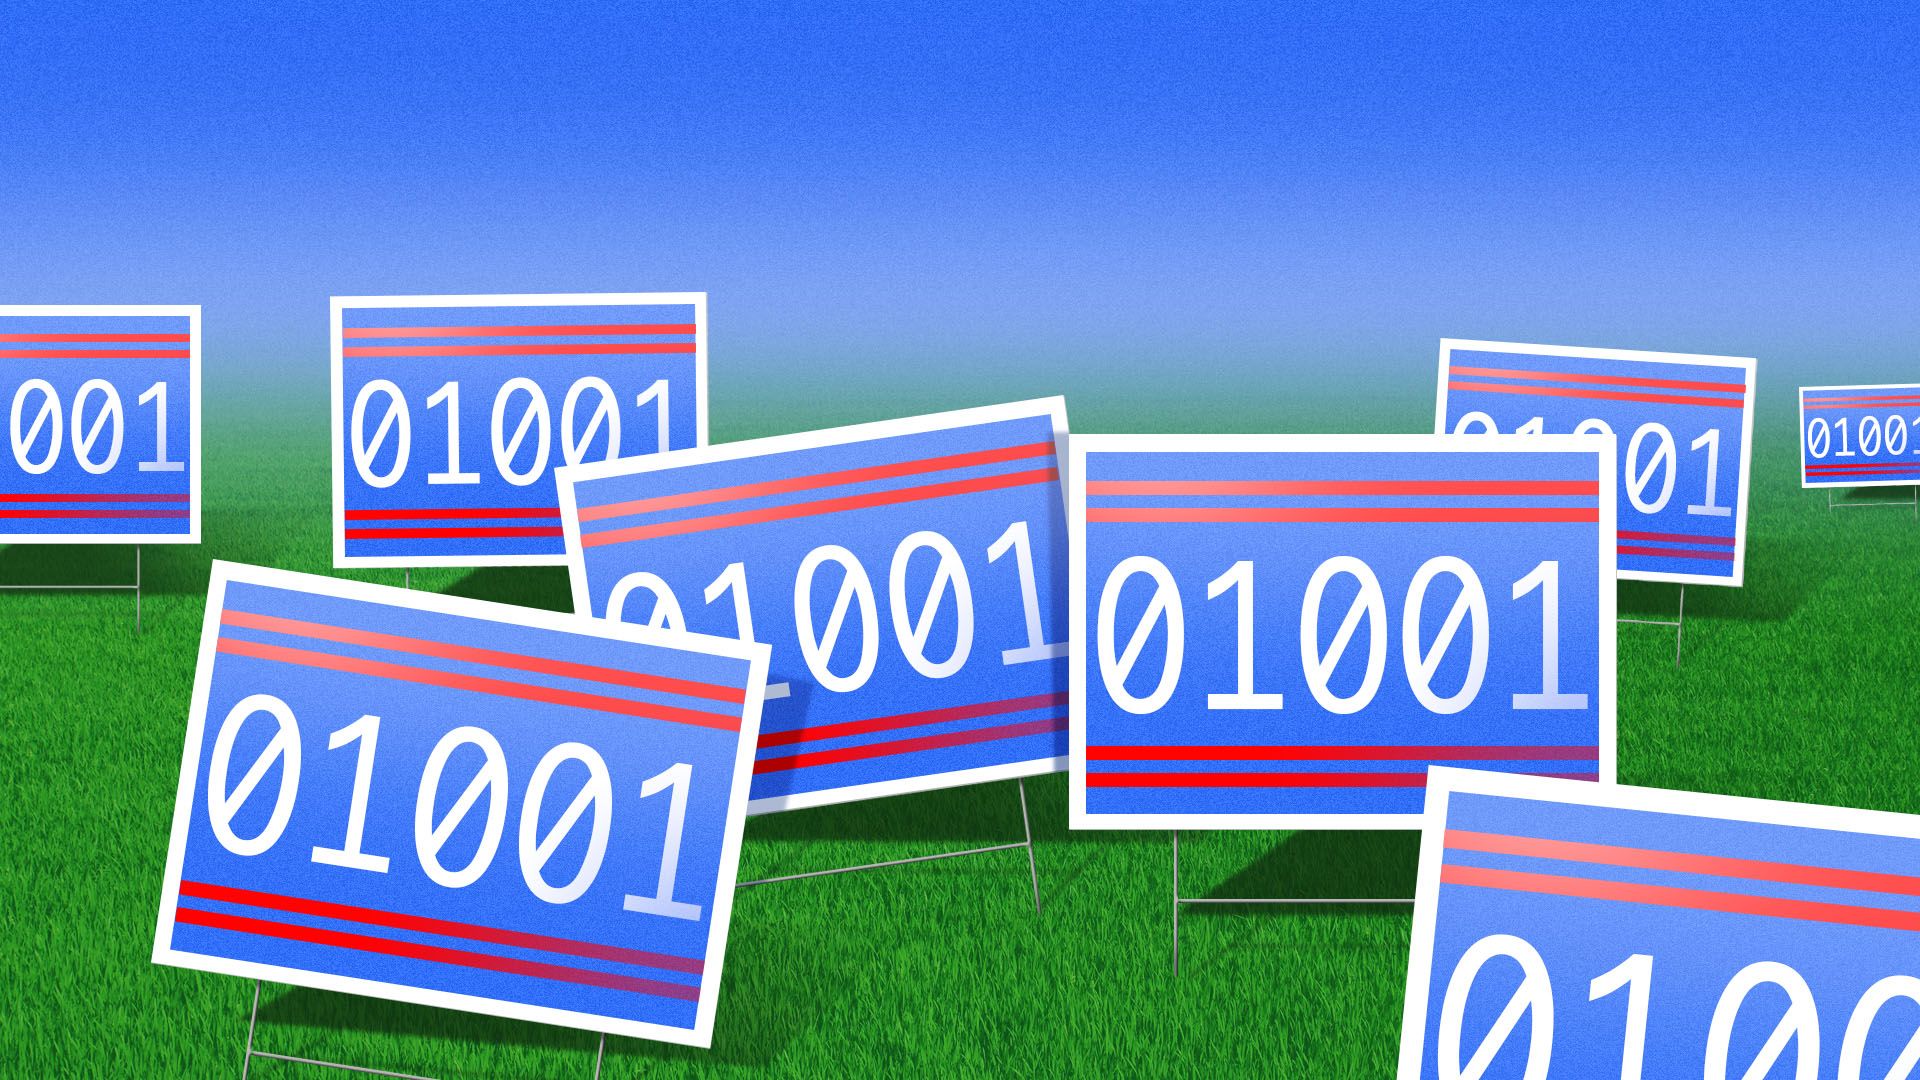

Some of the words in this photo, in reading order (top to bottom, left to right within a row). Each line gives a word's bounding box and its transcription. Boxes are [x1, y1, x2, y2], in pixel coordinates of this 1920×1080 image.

[10, 378, 185, 475] 001
[1097, 555, 1588, 714] 01001
[207, 693, 702, 921] 01001
